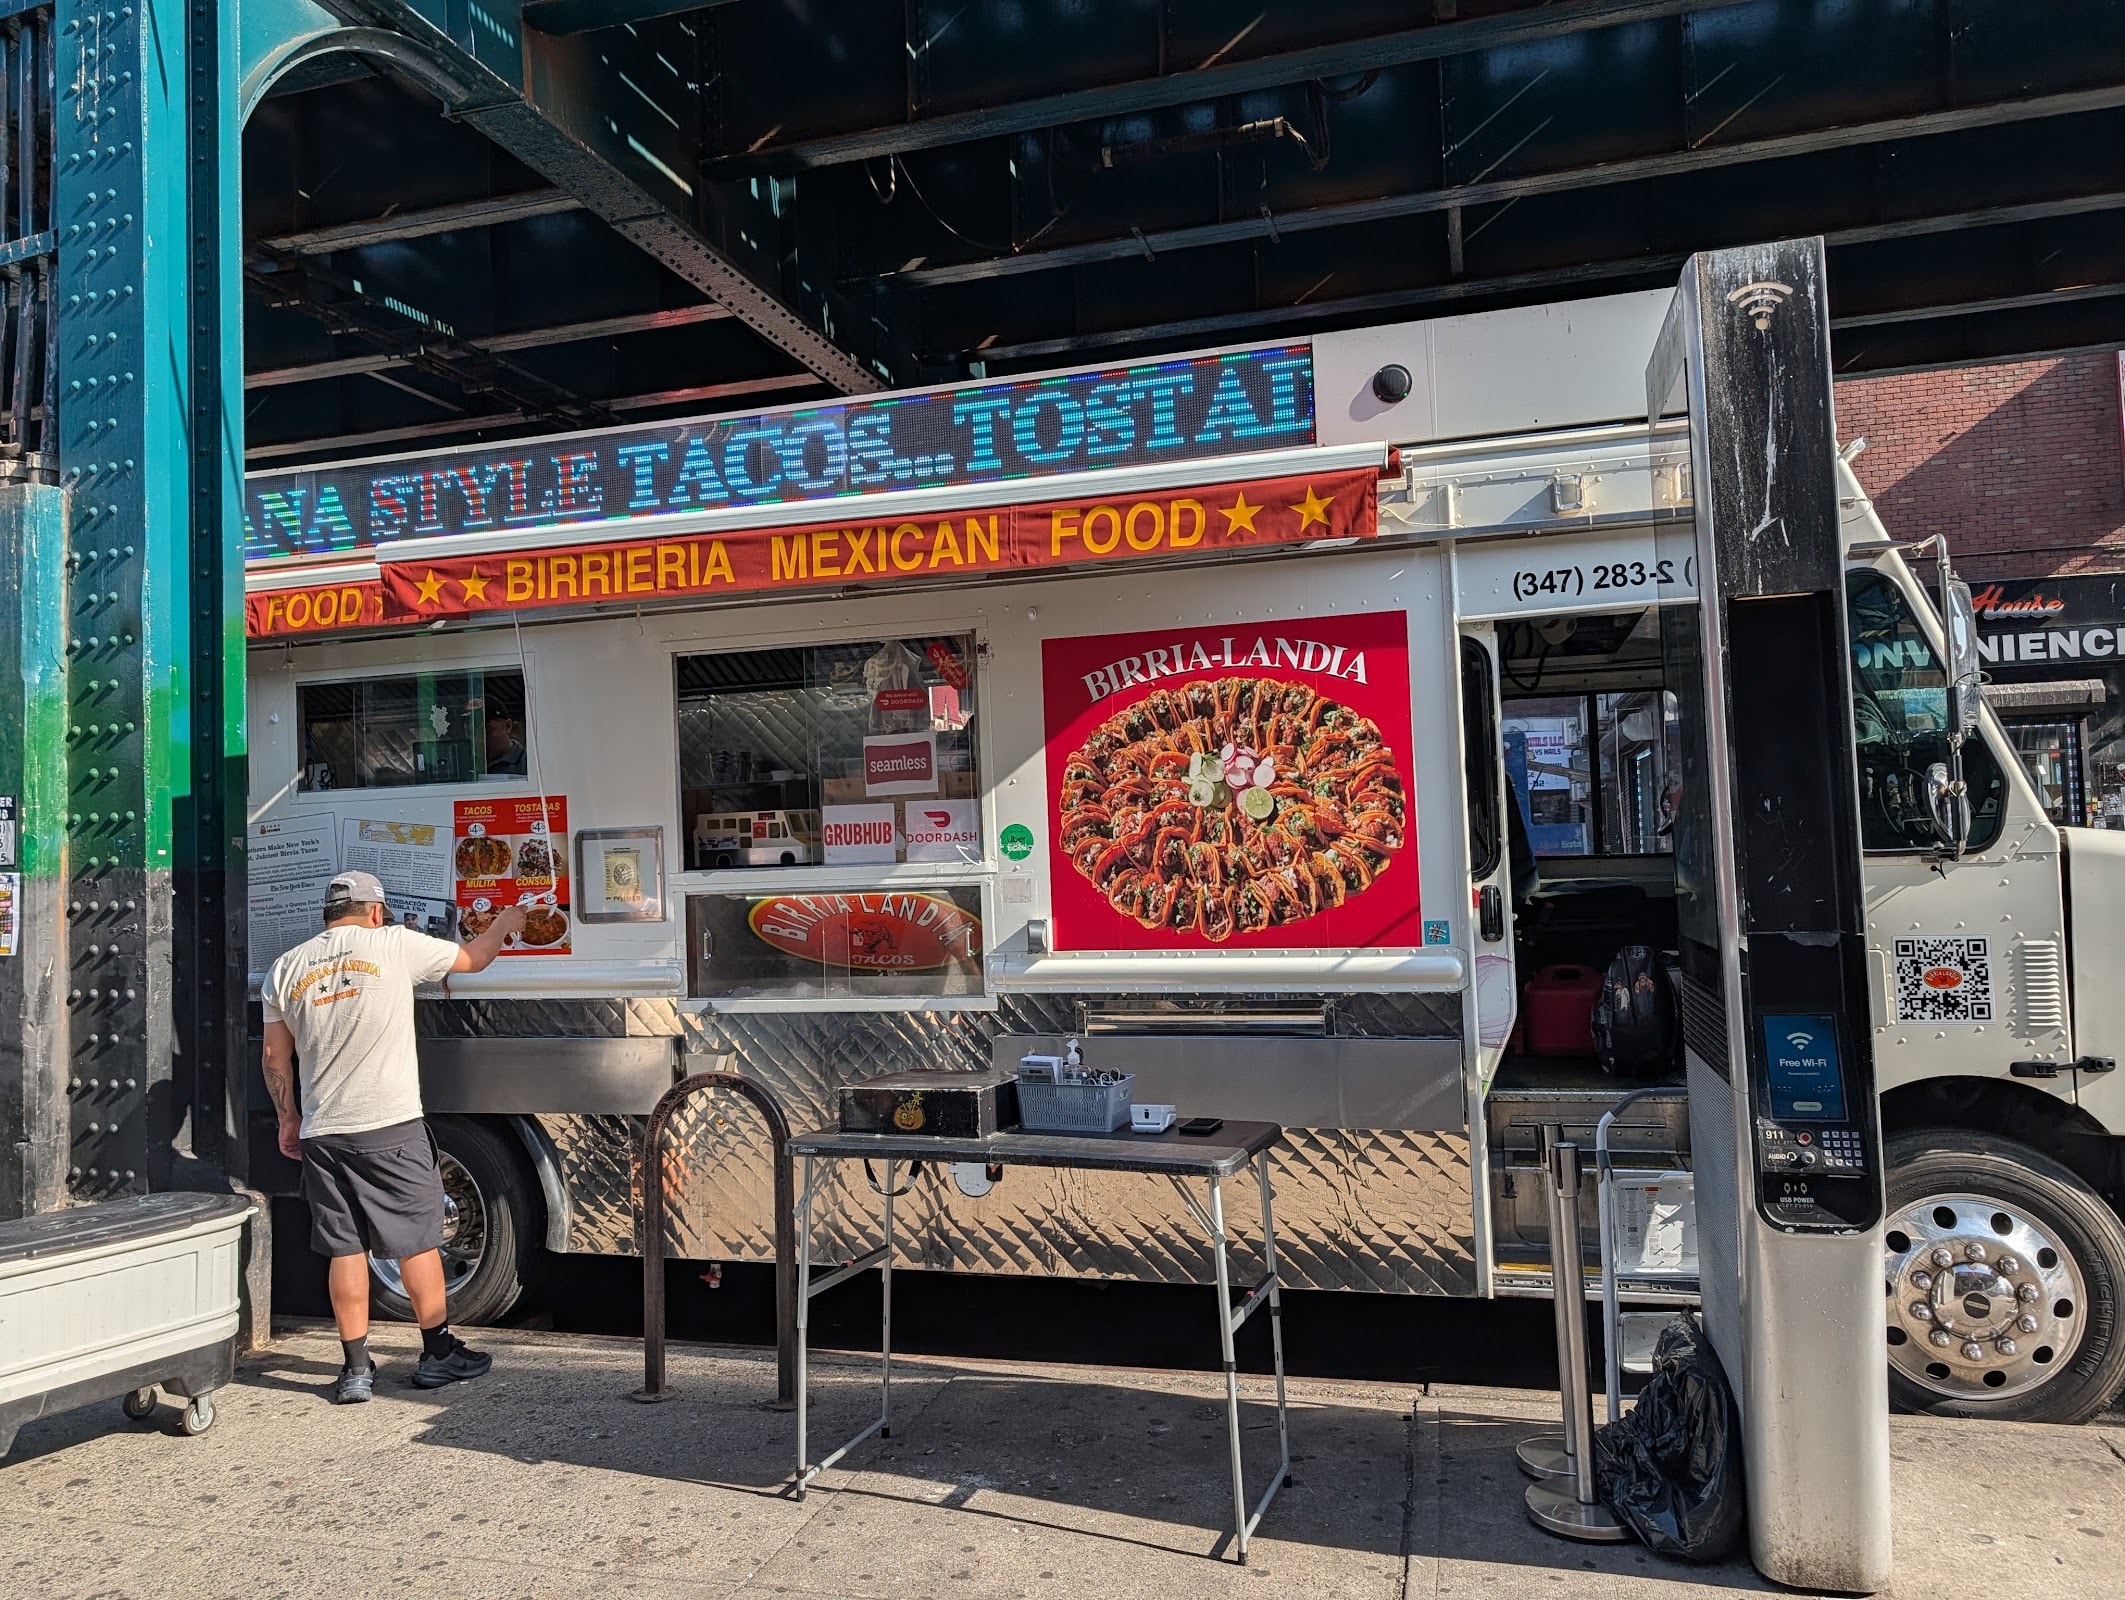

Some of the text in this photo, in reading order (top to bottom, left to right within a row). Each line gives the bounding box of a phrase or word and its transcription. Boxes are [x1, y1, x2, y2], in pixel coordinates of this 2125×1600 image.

[370, 452, 603, 540] STYLE
[505, 498, 1206, 603] BIRRIERIA MEXICAN FOOD
[1513, 566, 1584, 602] (347)
[267, 587, 363, 631] FOOD
[1971, 585, 2065, 620] House
[1080, 637, 1369, 703] BIRRIA-LANDIA
[870, 753, 927, 774] seamless
[463, 806, 493, 816] TACOS
[823, 821, 978, 846] GRUBHUB DOORDASH
[1007, 835, 1026, 843] Uber
[268, 843, 285, 851] Make
[286, 841, 300, 849] New
[466, 879, 497, 888] MULITA
[761, 894, 974, 947] BIRRIA-LANDIA
[852, 954, 916, 966] TACOS
[1779, 1058, 1827, 1068] Free Wi-Fi
[1765, 1130, 1784, 1140] 911
[1793, 1196, 1815, 1204] POWER
